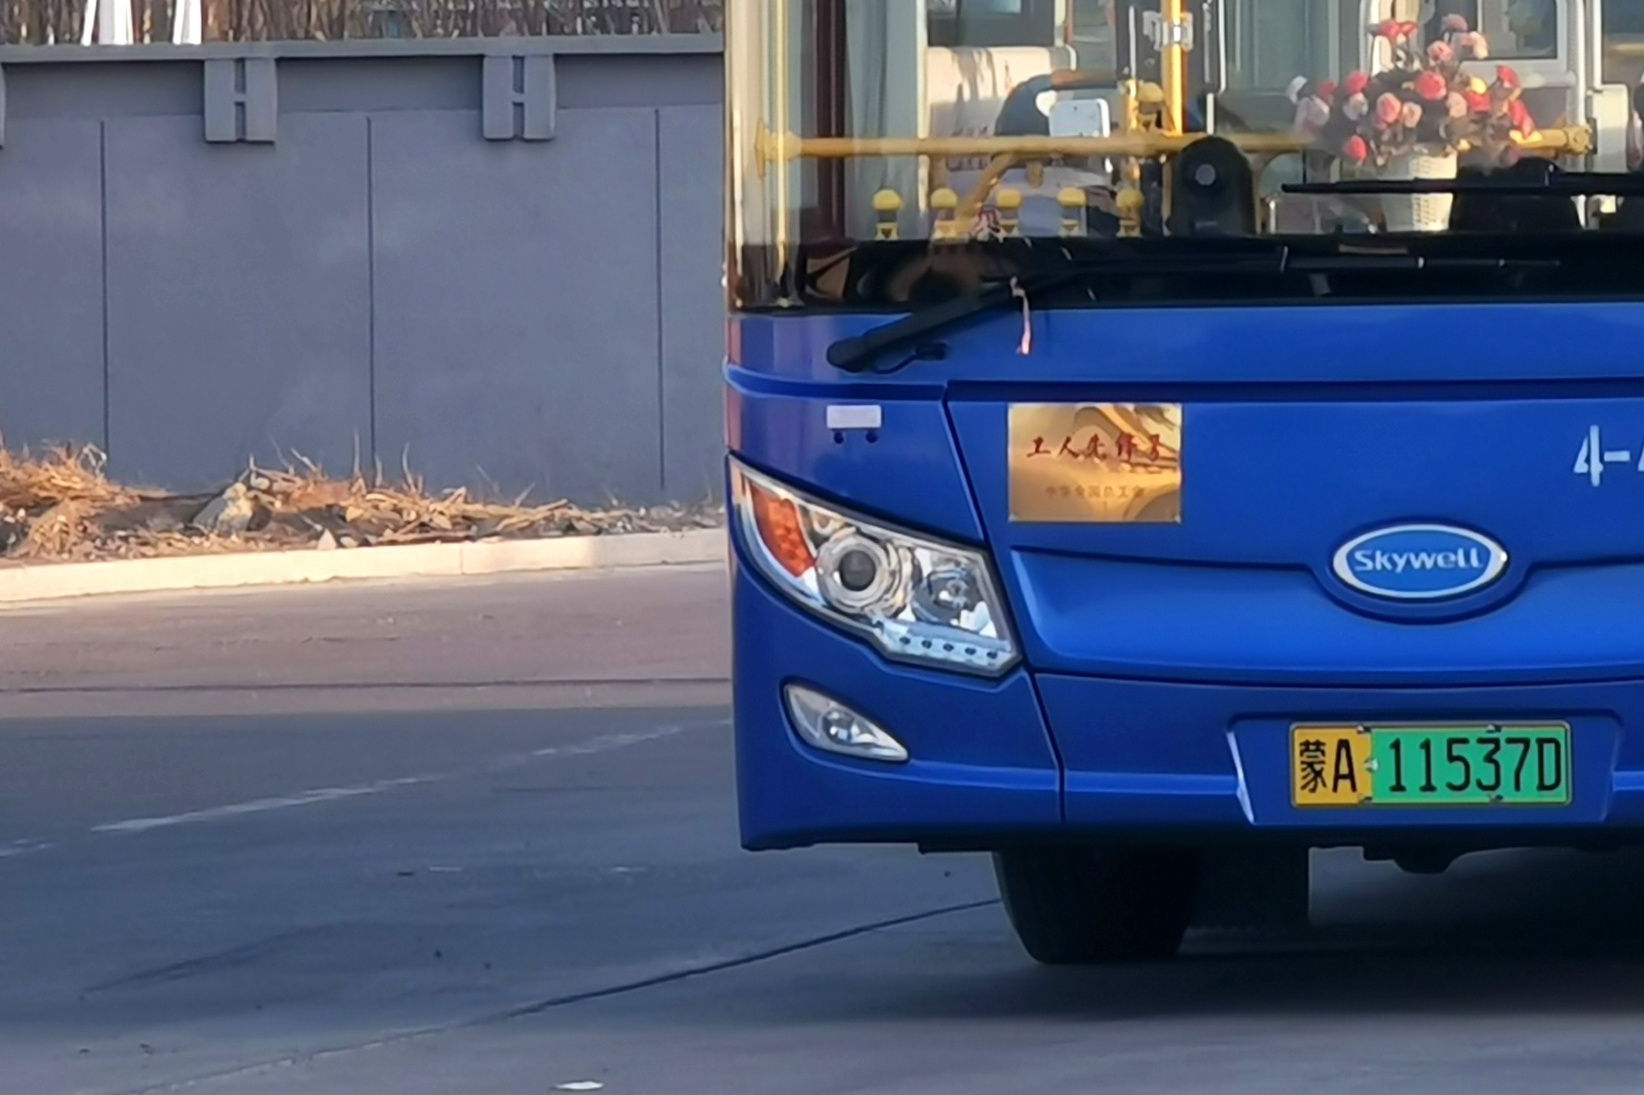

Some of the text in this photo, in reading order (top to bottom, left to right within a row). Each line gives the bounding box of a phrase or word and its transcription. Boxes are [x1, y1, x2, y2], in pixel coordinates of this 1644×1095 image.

[1353, 547, 1484, 573] Skywell
[1299, 737, 1562, 793] 蒙A 11537D
